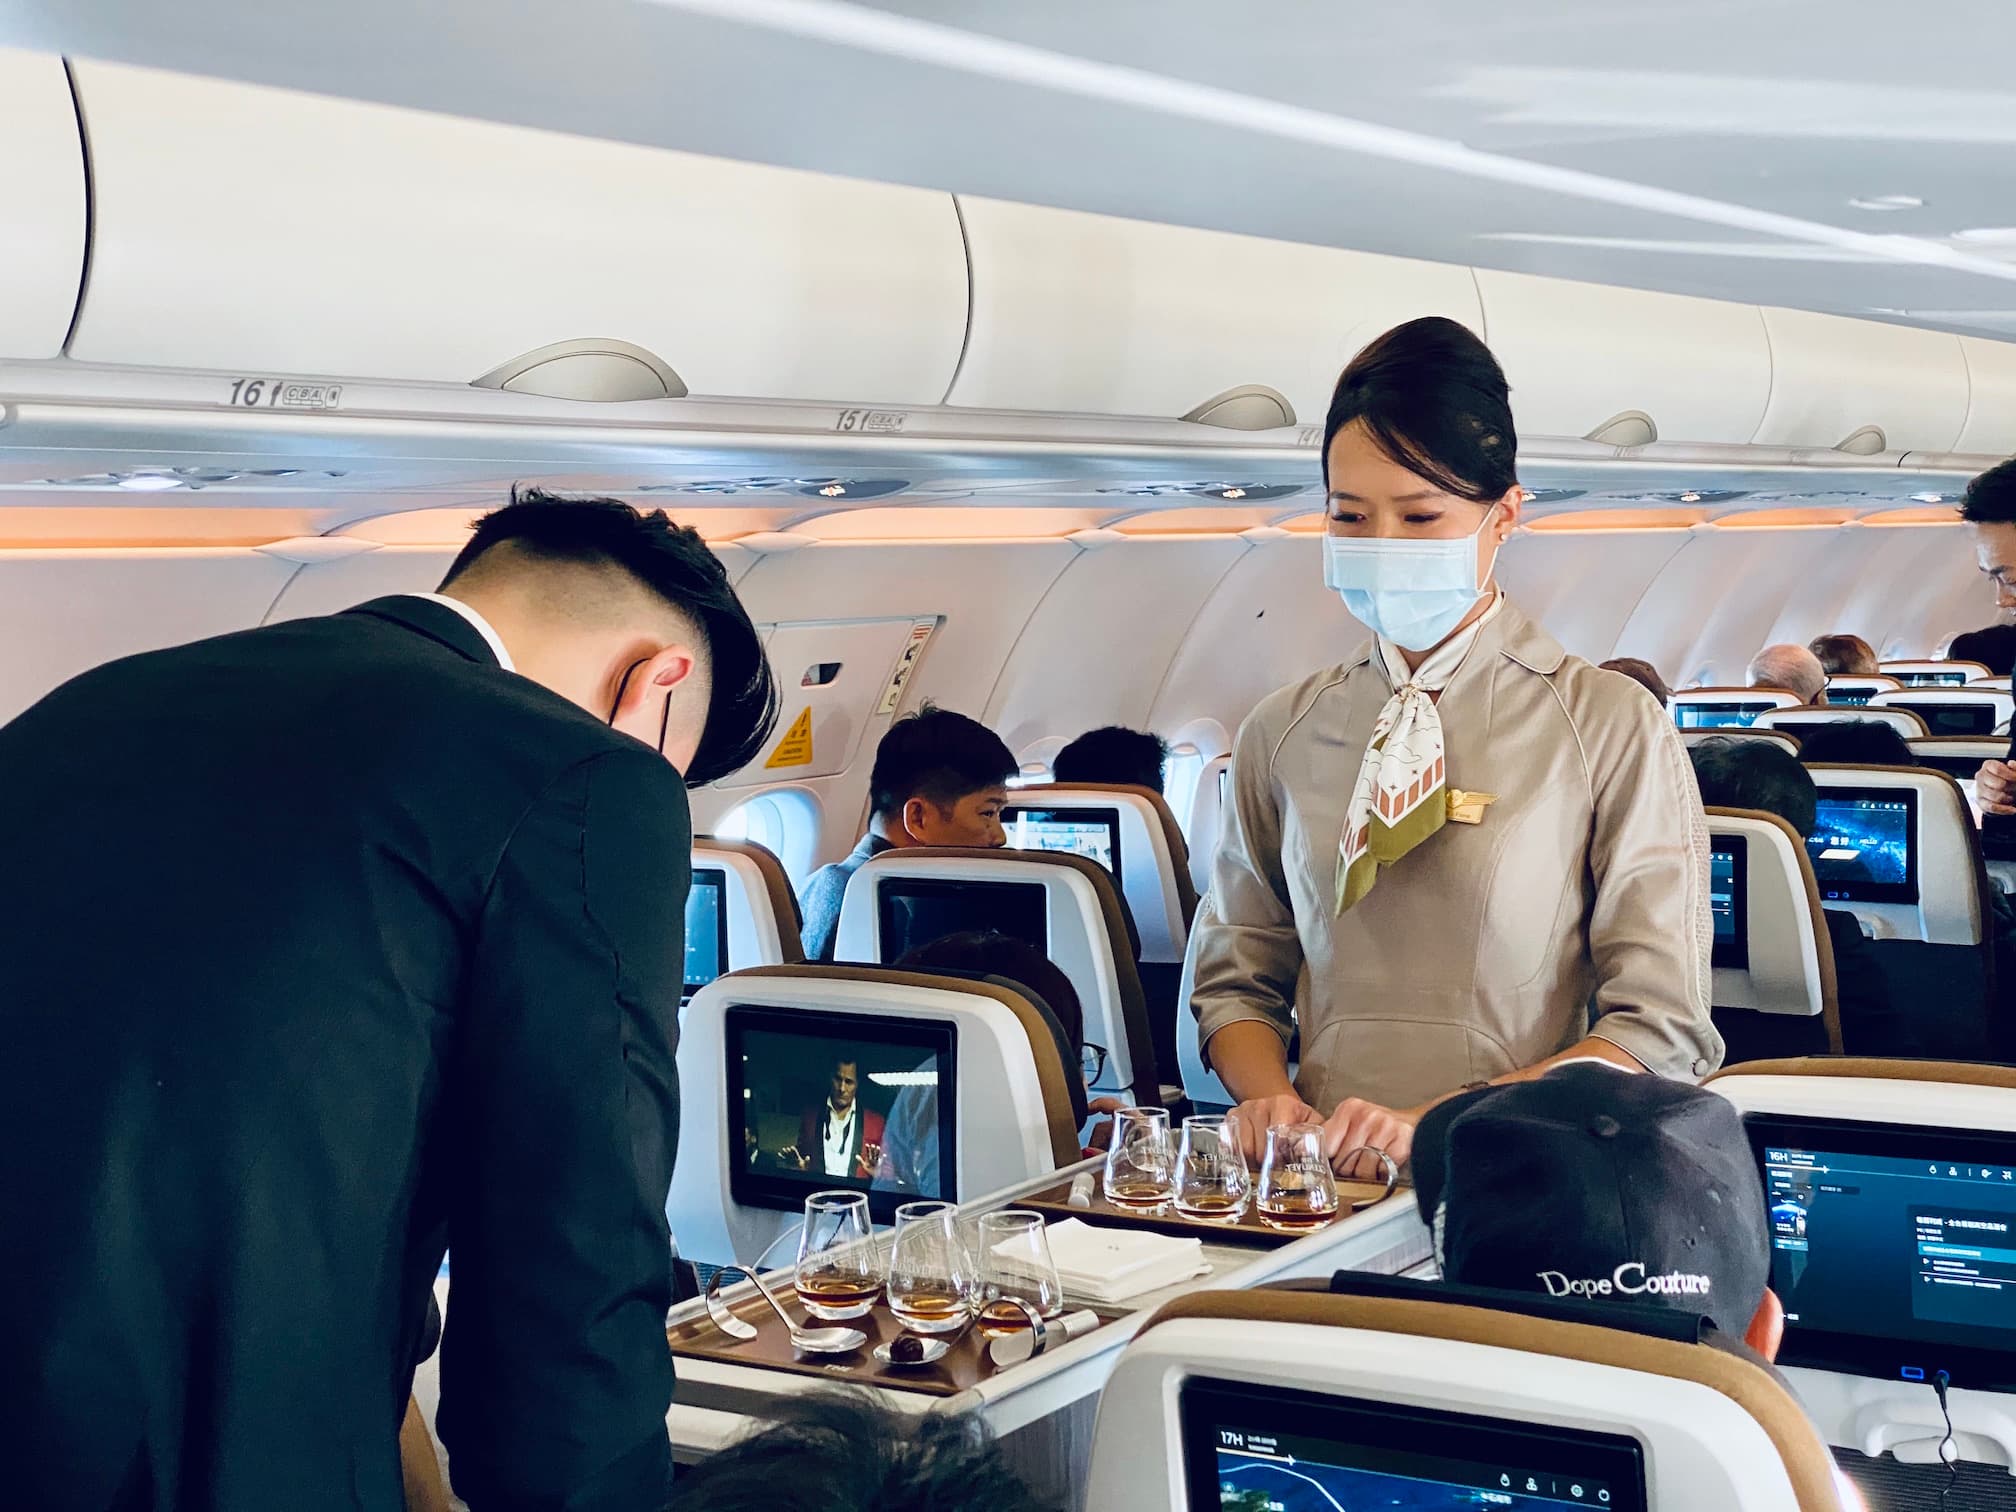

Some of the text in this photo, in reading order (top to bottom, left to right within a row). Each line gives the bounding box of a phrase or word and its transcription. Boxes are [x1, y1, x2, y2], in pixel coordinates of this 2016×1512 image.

[231, 379, 265, 406] 16
[836, 408, 861, 430] 15
[1769, 1152, 1789, 1162] 16H
[1221, 1431, 1243, 1446] 17H
